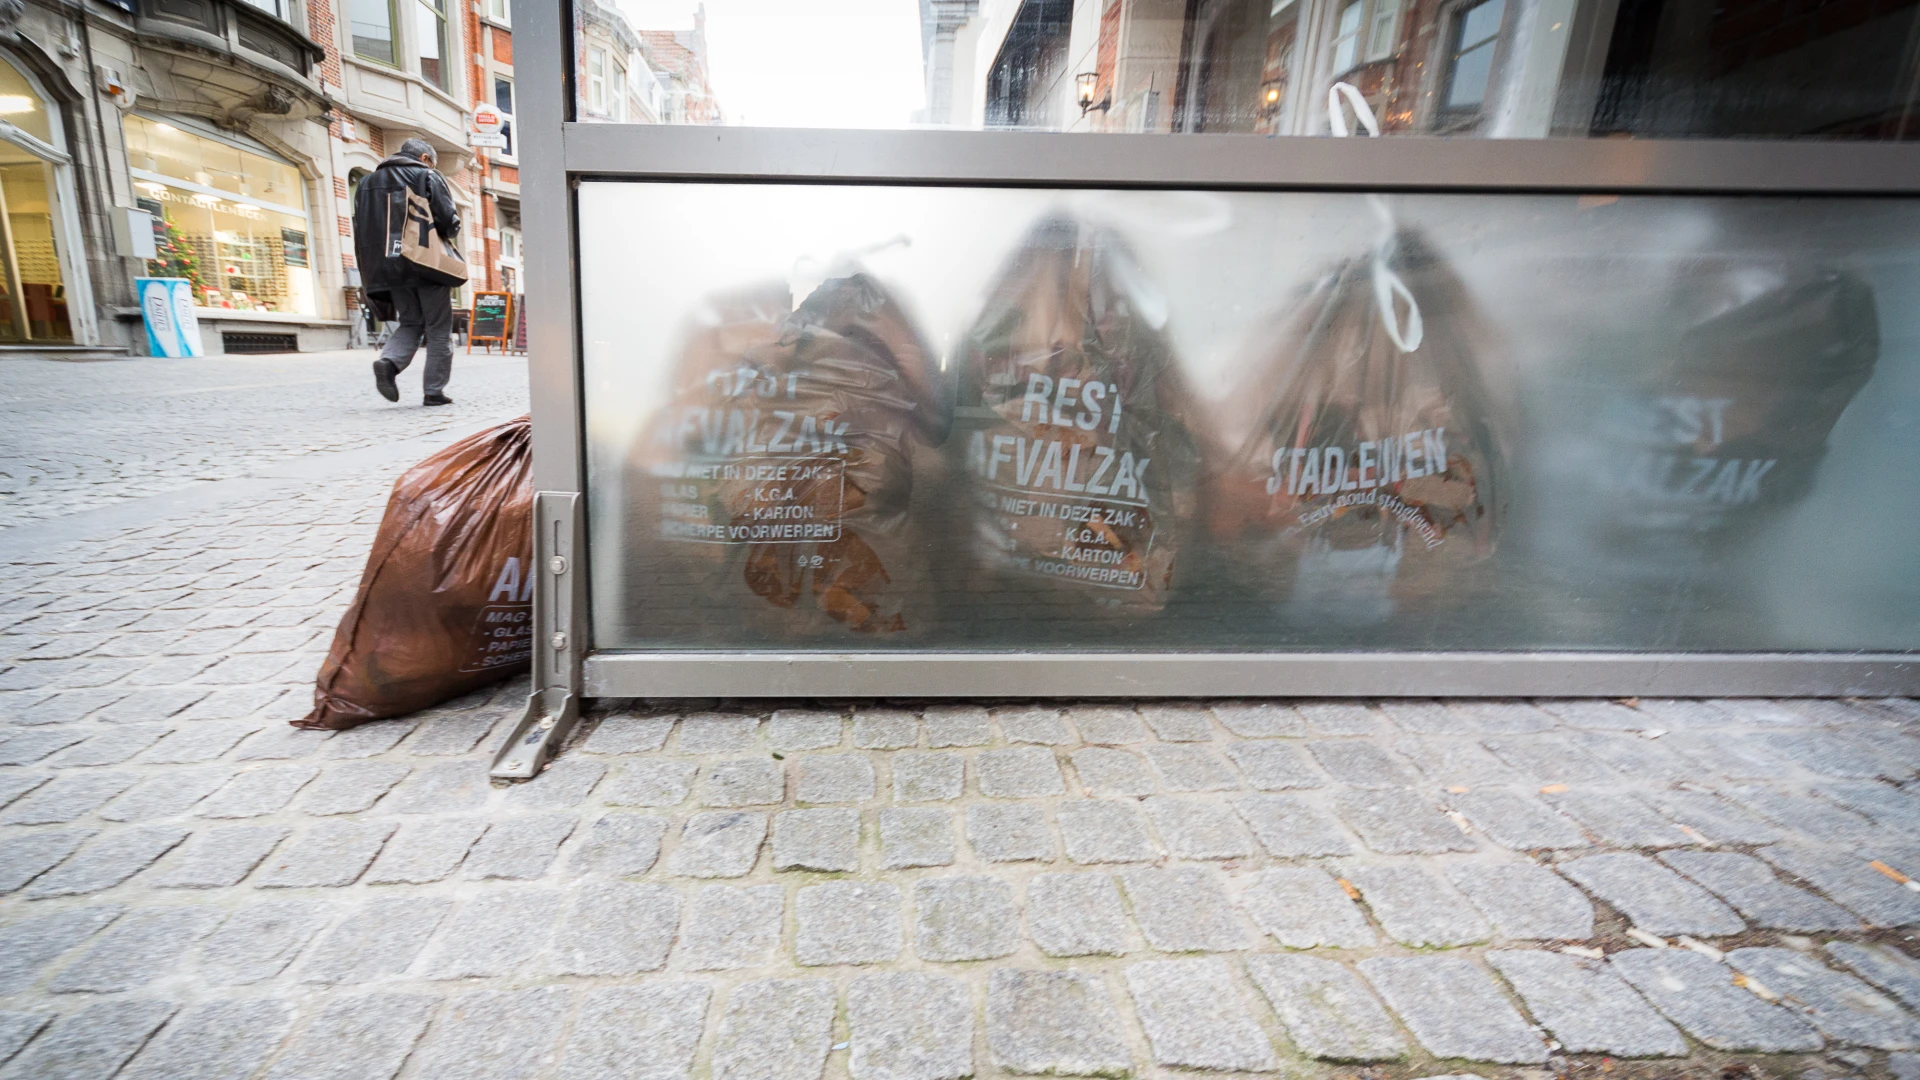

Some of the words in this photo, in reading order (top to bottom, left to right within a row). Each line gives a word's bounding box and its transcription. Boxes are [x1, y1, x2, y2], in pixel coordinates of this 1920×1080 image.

[723, 465, 740, 480] IN
[744, 466, 787, 482] DEZE
[753, 506, 814, 520] KARTON
[1039, 503, 1056, 519] IN
[1059, 506, 1102, 523] DEZE
[728, 524, 834, 539] VOORWERPEN
[1060, 545, 1124, 564] KARTON
[1035, 559, 1140, 585] VOORWERPEN
[485, 611, 527, 623] MAG
